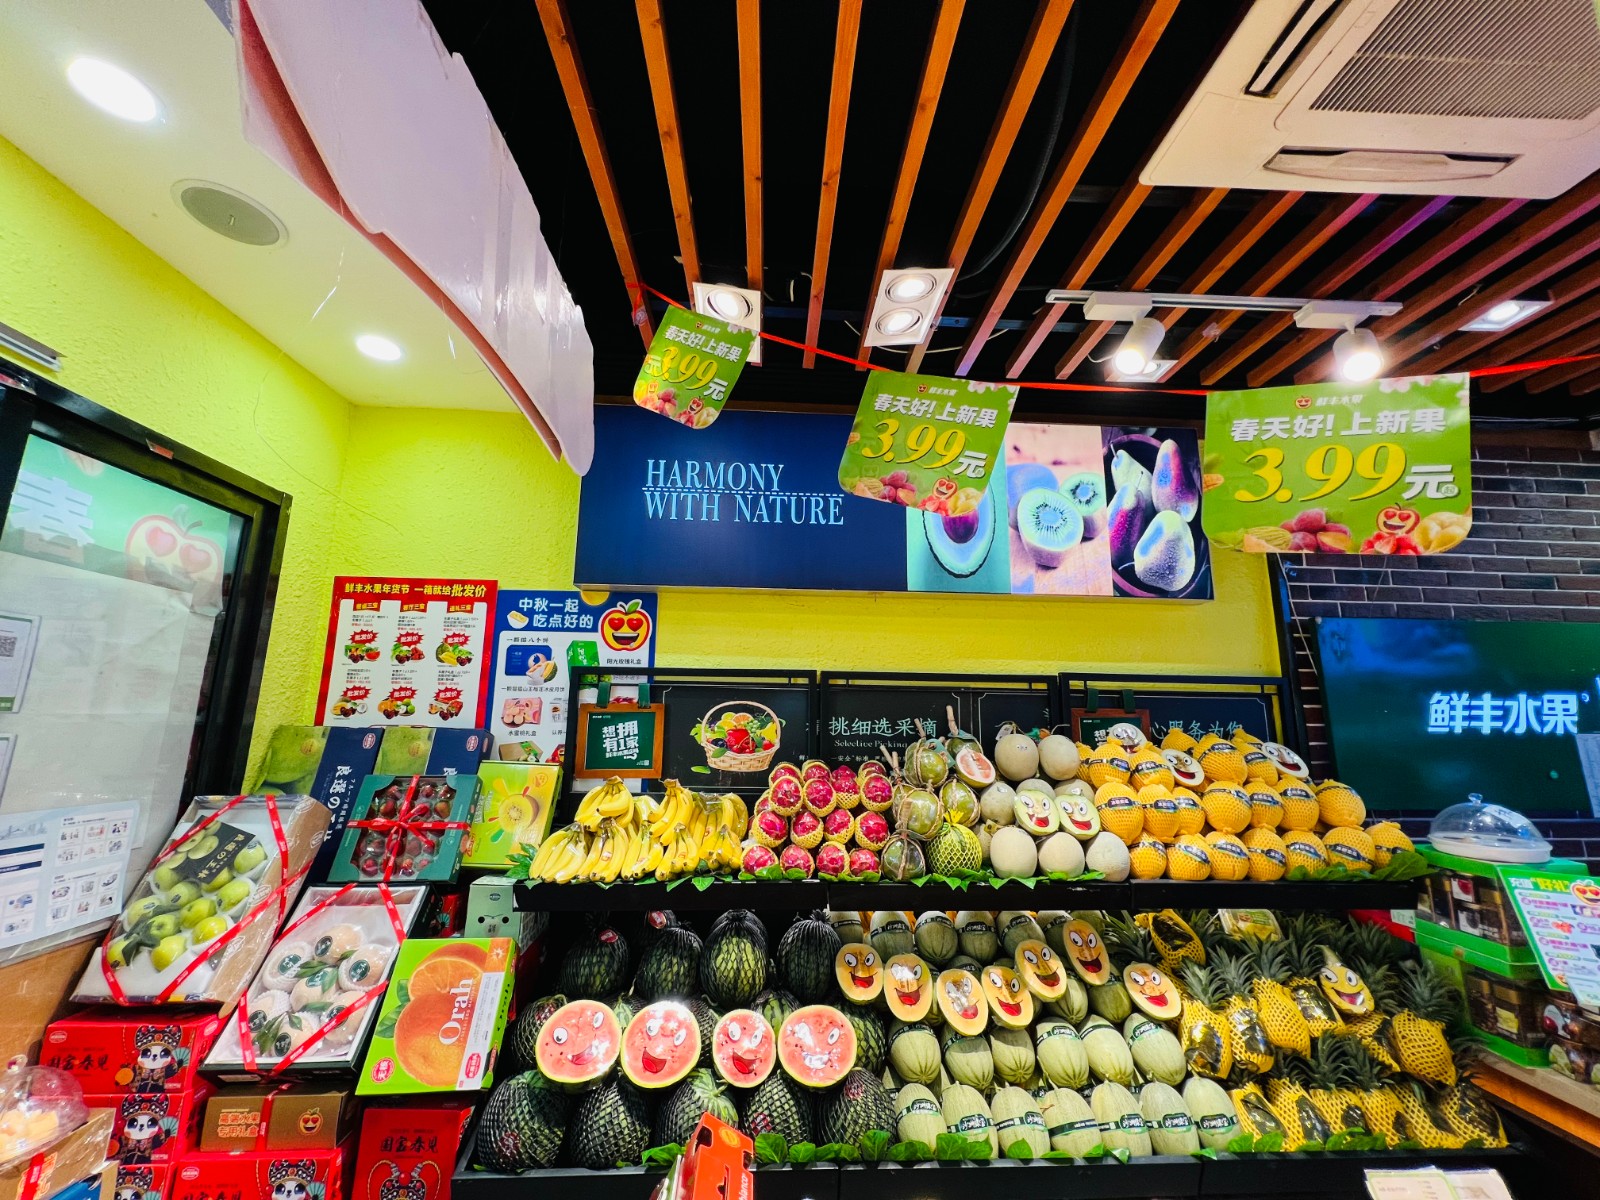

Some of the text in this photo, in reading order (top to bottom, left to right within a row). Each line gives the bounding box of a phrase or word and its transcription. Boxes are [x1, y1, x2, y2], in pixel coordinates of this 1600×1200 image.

[646, 459, 784, 491] HARMONY
[644, 491, 844, 526] WITH NATURE
[345, 583, 487, 597] 鲜丰水果年货节 一箱就给批发价
[519, 597, 579, 613] 中秋一起
[533, 614, 594, 629] 吃点好的
[1428, 691, 1578, 734] 鲜丰水果
[438, 978, 474, 1045] Orah
